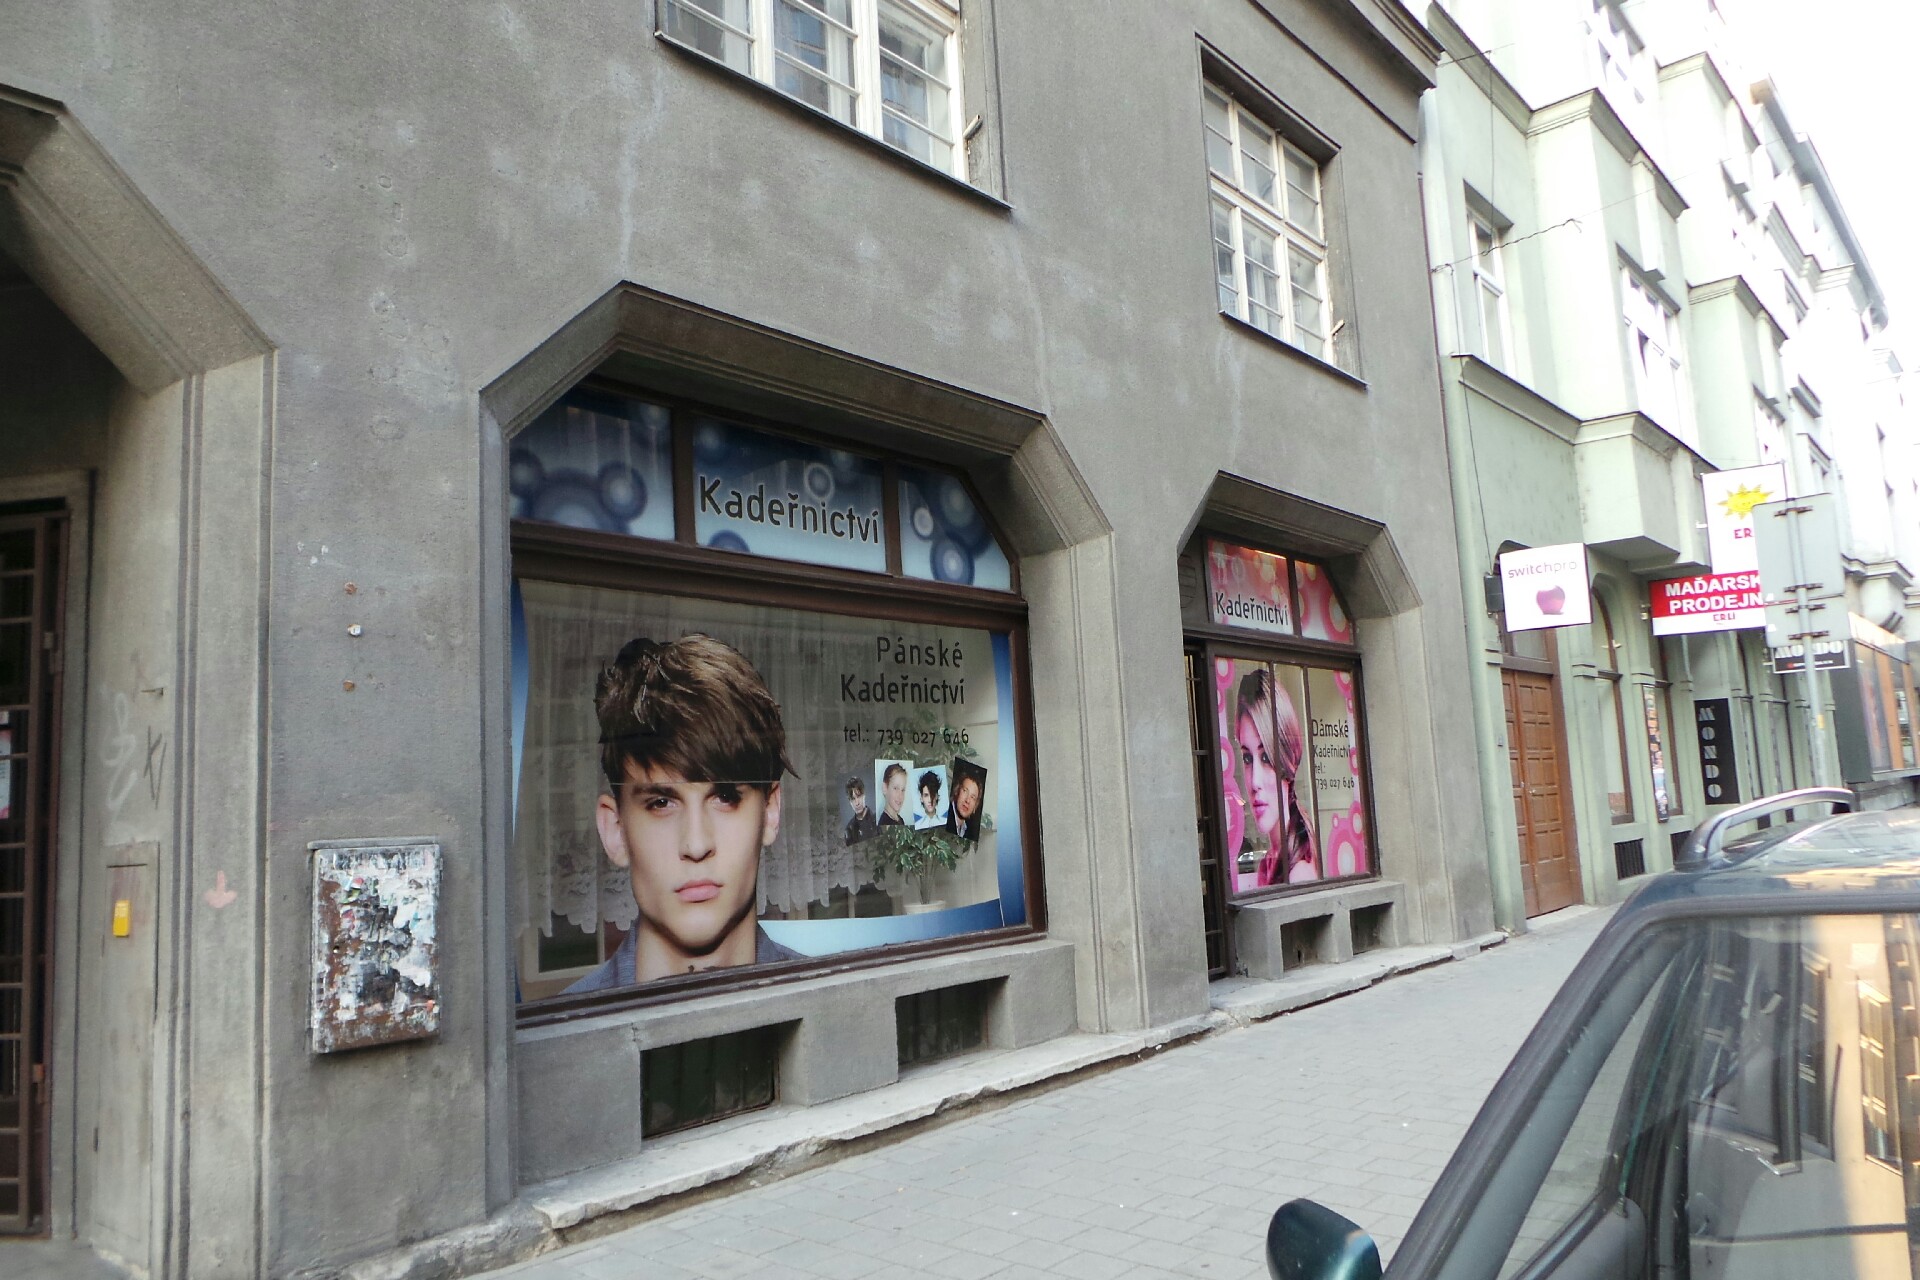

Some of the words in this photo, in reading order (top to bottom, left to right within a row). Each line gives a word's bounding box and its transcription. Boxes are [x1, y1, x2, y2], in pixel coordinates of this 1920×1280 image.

[699, 475, 880, 544] Kadeřnictví
[1733, 527, 1754, 540] ER
[1508, 561, 1577, 578] switchpro
[1665, 573, 1762, 597] MAĎARSK
[1215, 592, 1289, 626] Kadeřnictví
[1669, 592, 1764, 614] PRODEJN
[876, 636, 963, 668] Pánské
[1774, 640, 1844, 659] MODO
[840, 672, 965, 705] Kadeřnictví
[843, 722, 870, 743] tel.:
[877, 729, 904, 746] 739
[912, 732, 936, 748] 027
[943, 728, 969, 747] 646
[1312, 718, 1349, 738] Dámské
[1698, 707, 1723, 798] MONDO
[1329, 778, 1341, 790] 027
